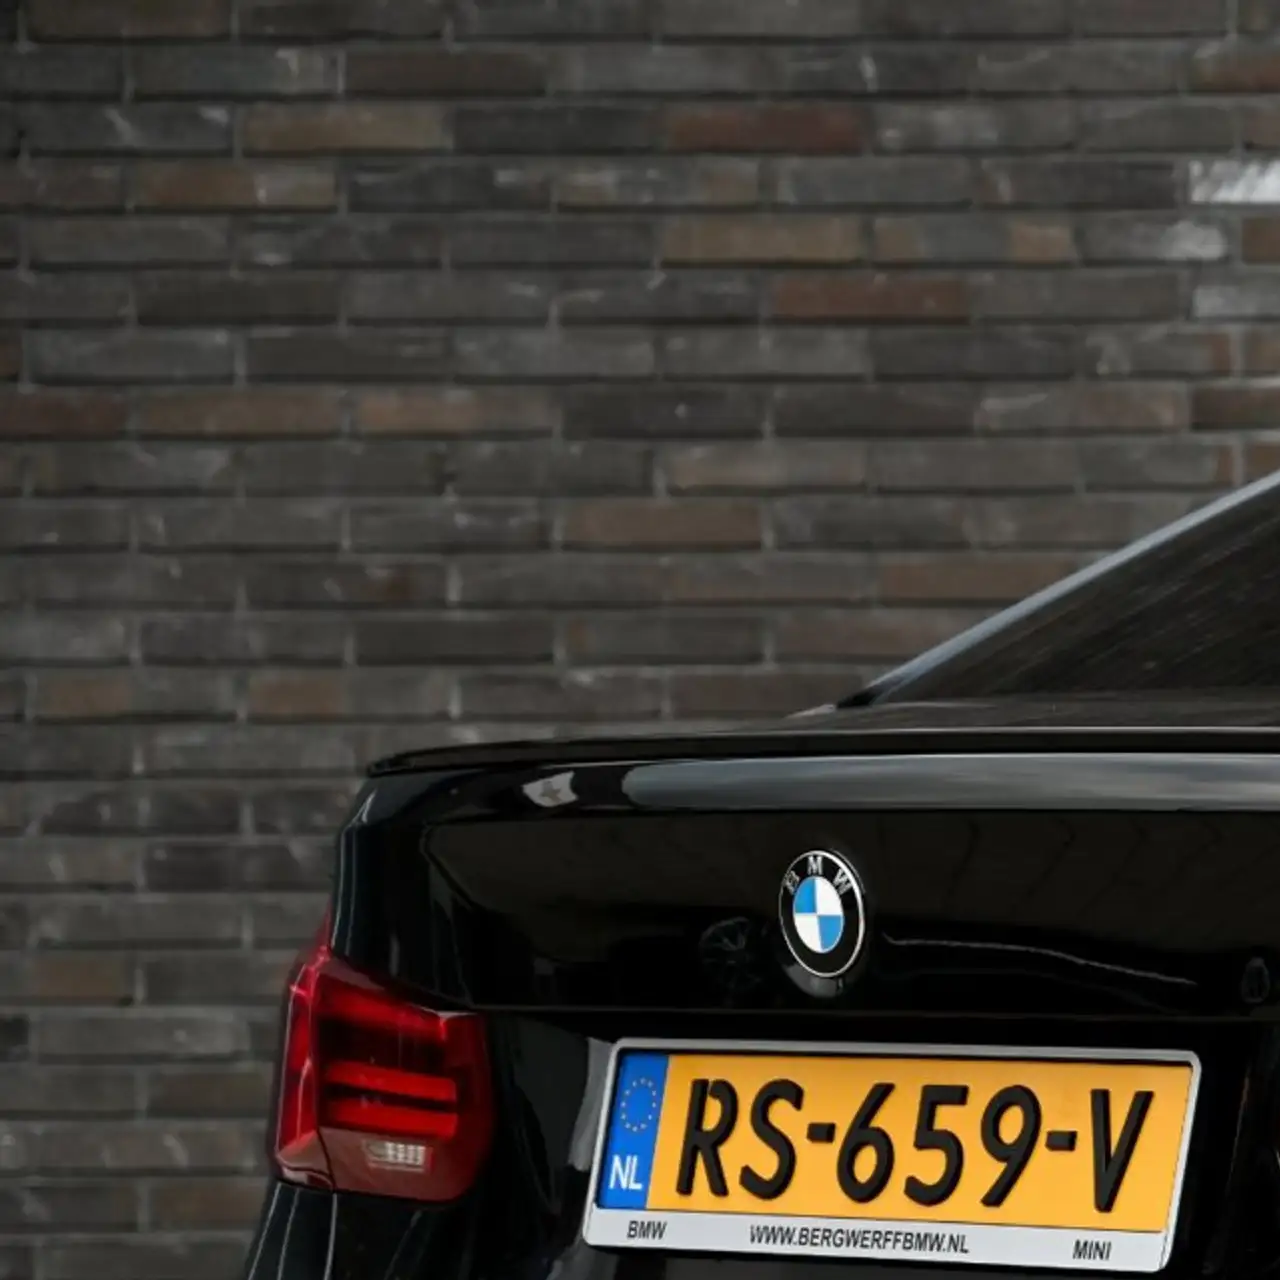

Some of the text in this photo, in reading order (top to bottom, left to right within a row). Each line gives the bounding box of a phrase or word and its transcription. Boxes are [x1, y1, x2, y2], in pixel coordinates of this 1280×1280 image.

[784, 855, 853, 896] BMW
[675, 1078, 1154, 1214] RS-659-V
[608, 1154, 643, 1192] NL
[626, 1220, 668, 1242] BMW
[749, 1224, 971, 1257] WWW.BERGWERFFBMW.NL
[1071, 1239, 1112, 1262] MINI
